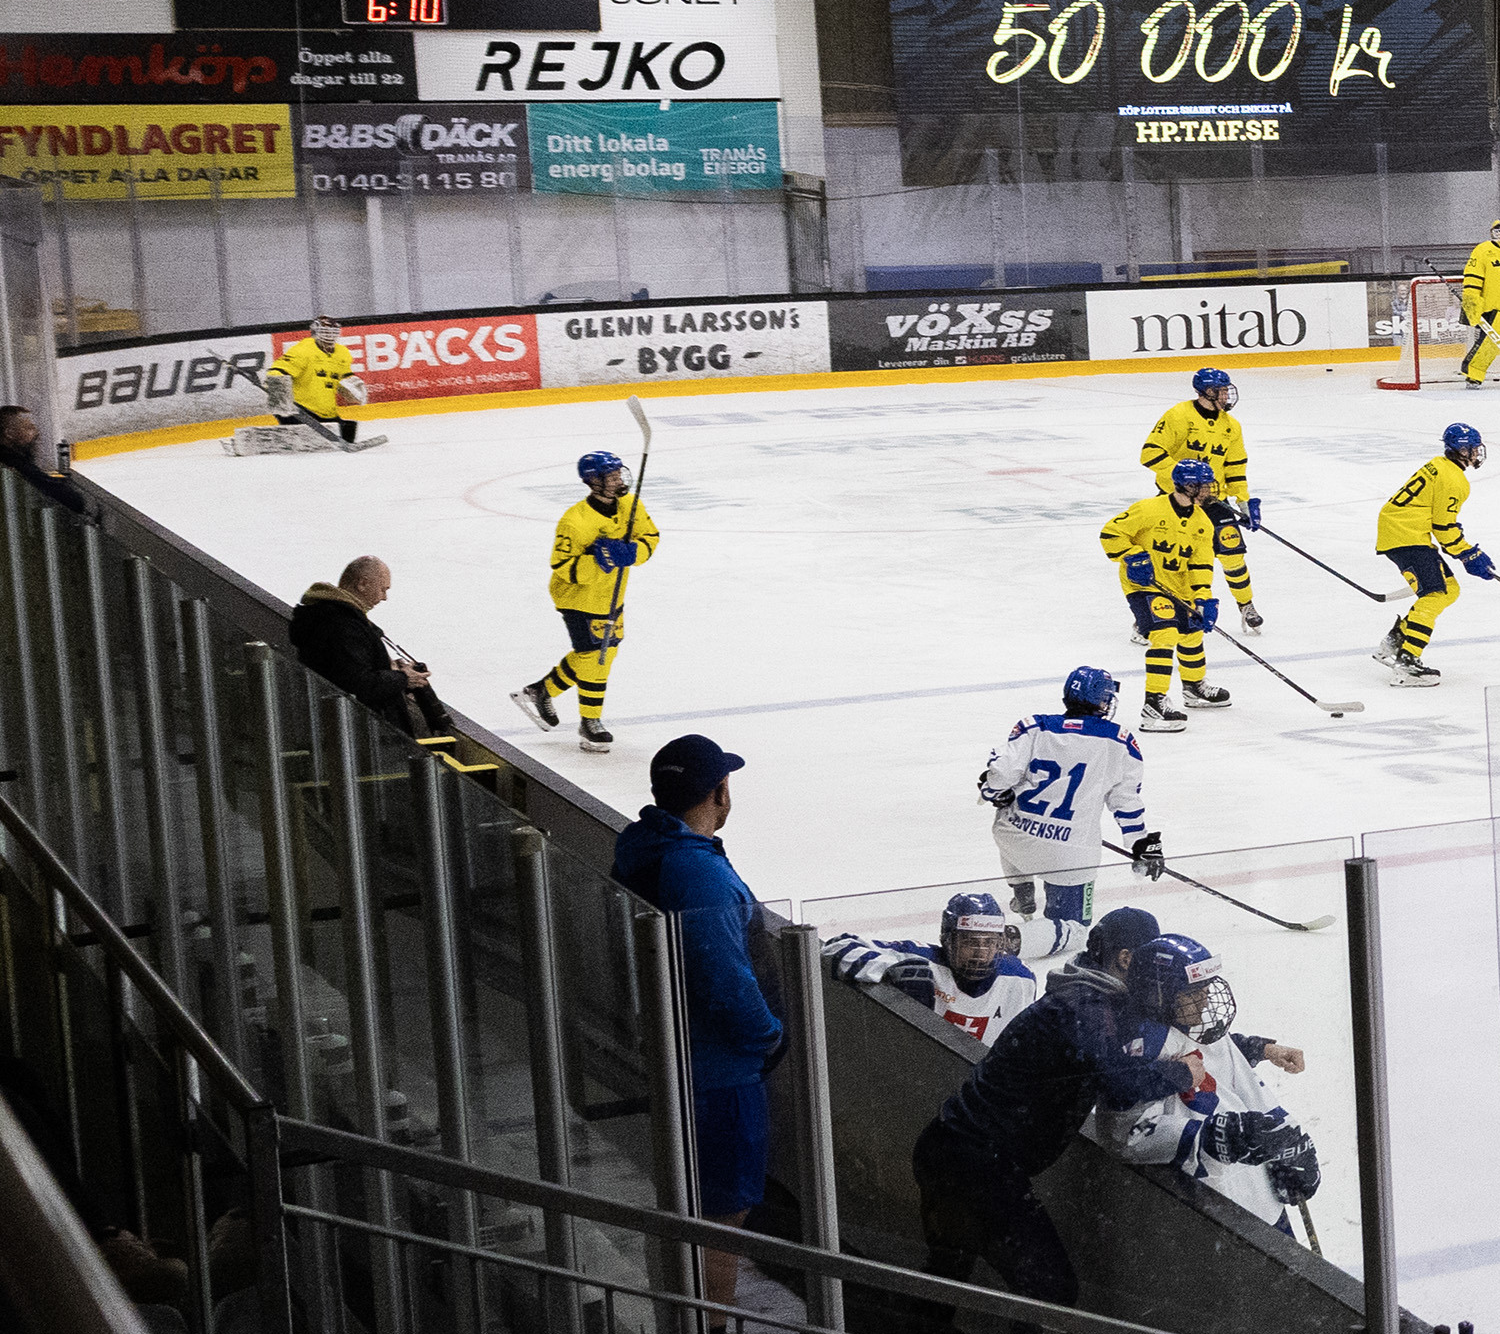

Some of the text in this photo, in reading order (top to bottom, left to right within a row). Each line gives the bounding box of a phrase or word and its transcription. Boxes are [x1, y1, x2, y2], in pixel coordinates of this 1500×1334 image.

[299, 46, 393, 67] Öppet alla
[1329, 2, 1397, 97] kr
[475, 40, 726, 92] REJKO
[290, 71, 405, 88] dagar till 22
[0, 123, 281, 158] FYNDLAGRET
[301, 117, 518, 149] B&BS DÄCK
[1136, 119, 1280, 143] HP.TAIF.SE
[547, 132, 671, 155] Ditt lokala
[700, 143, 767, 161] TRANÅS
[549, 158, 686, 182] energbolag
[703, 160, 767, 175] ENERGI
[1132, 288, 1308, 353] mitab
[904, 332, 1037, 353] Maskin AB
[636, 343, 732, 375] BYGG
[1015, 757, 1087, 822] 21
